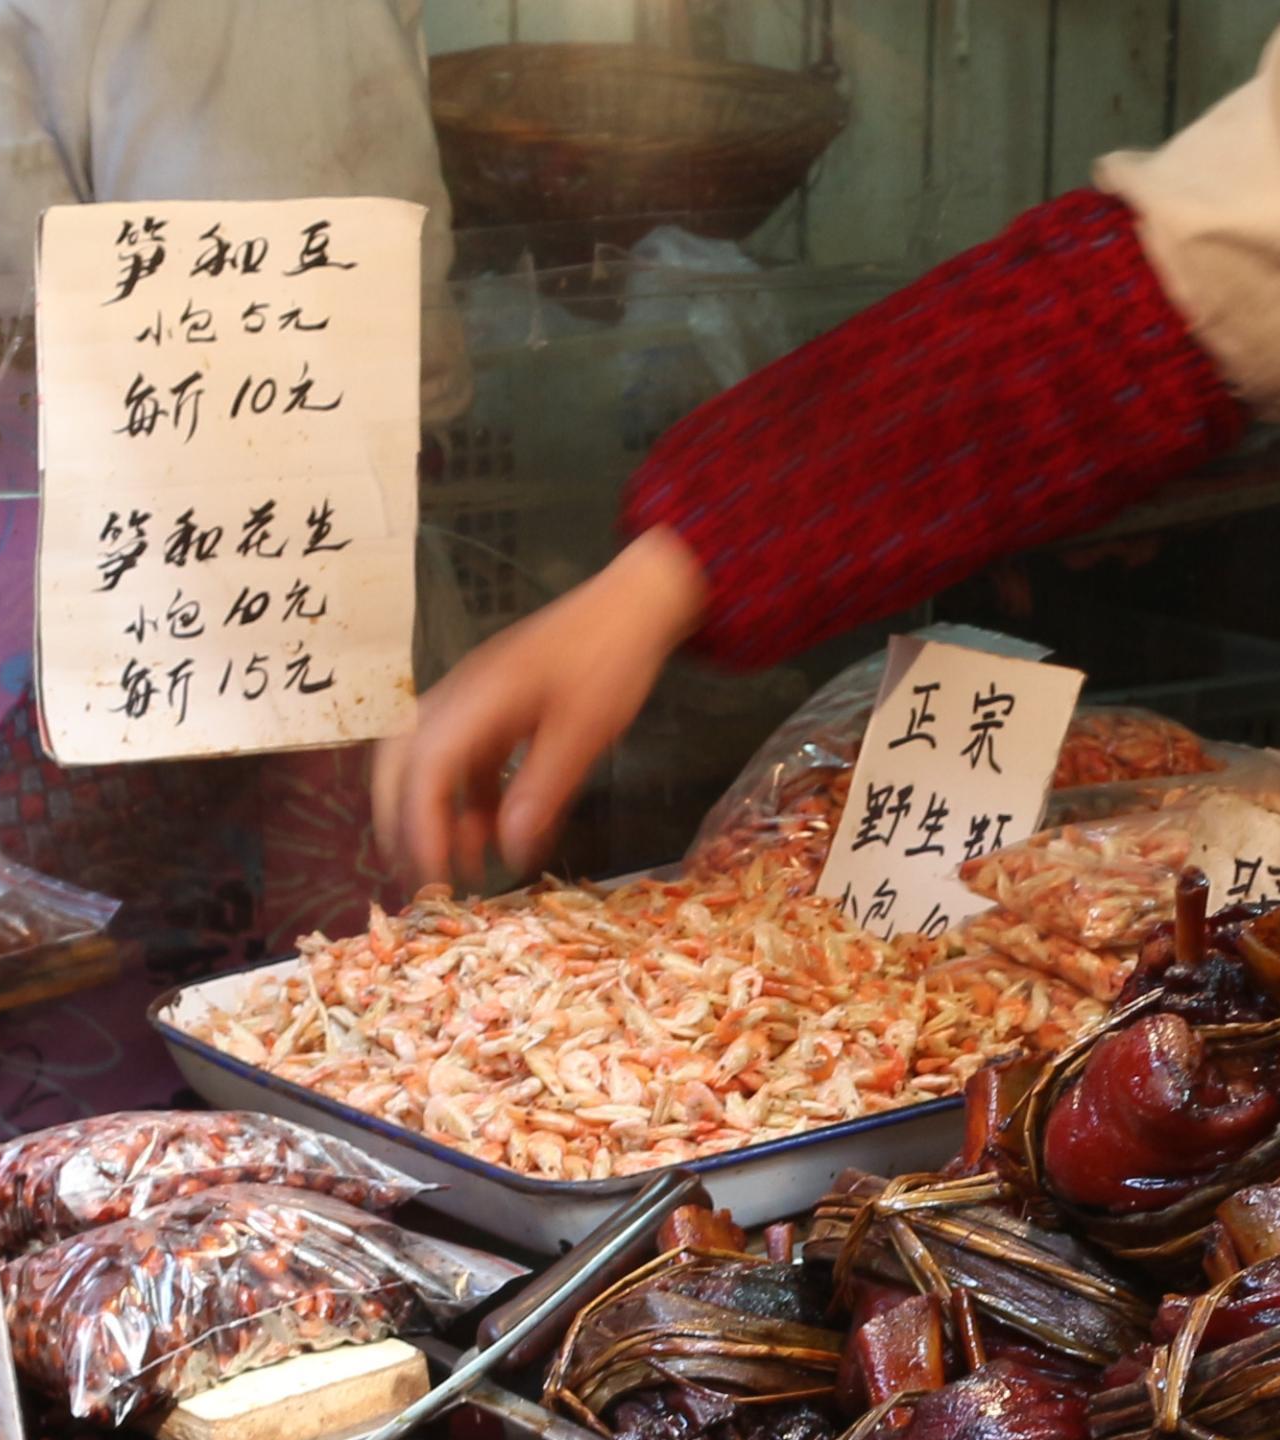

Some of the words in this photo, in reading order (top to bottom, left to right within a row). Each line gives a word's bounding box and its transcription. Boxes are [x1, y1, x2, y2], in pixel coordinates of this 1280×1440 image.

[104, 216, 360, 305] 笋和豆
[92, 499, 352, 593] 笋和花生
[888, 681, 1016, 774] 正宗
